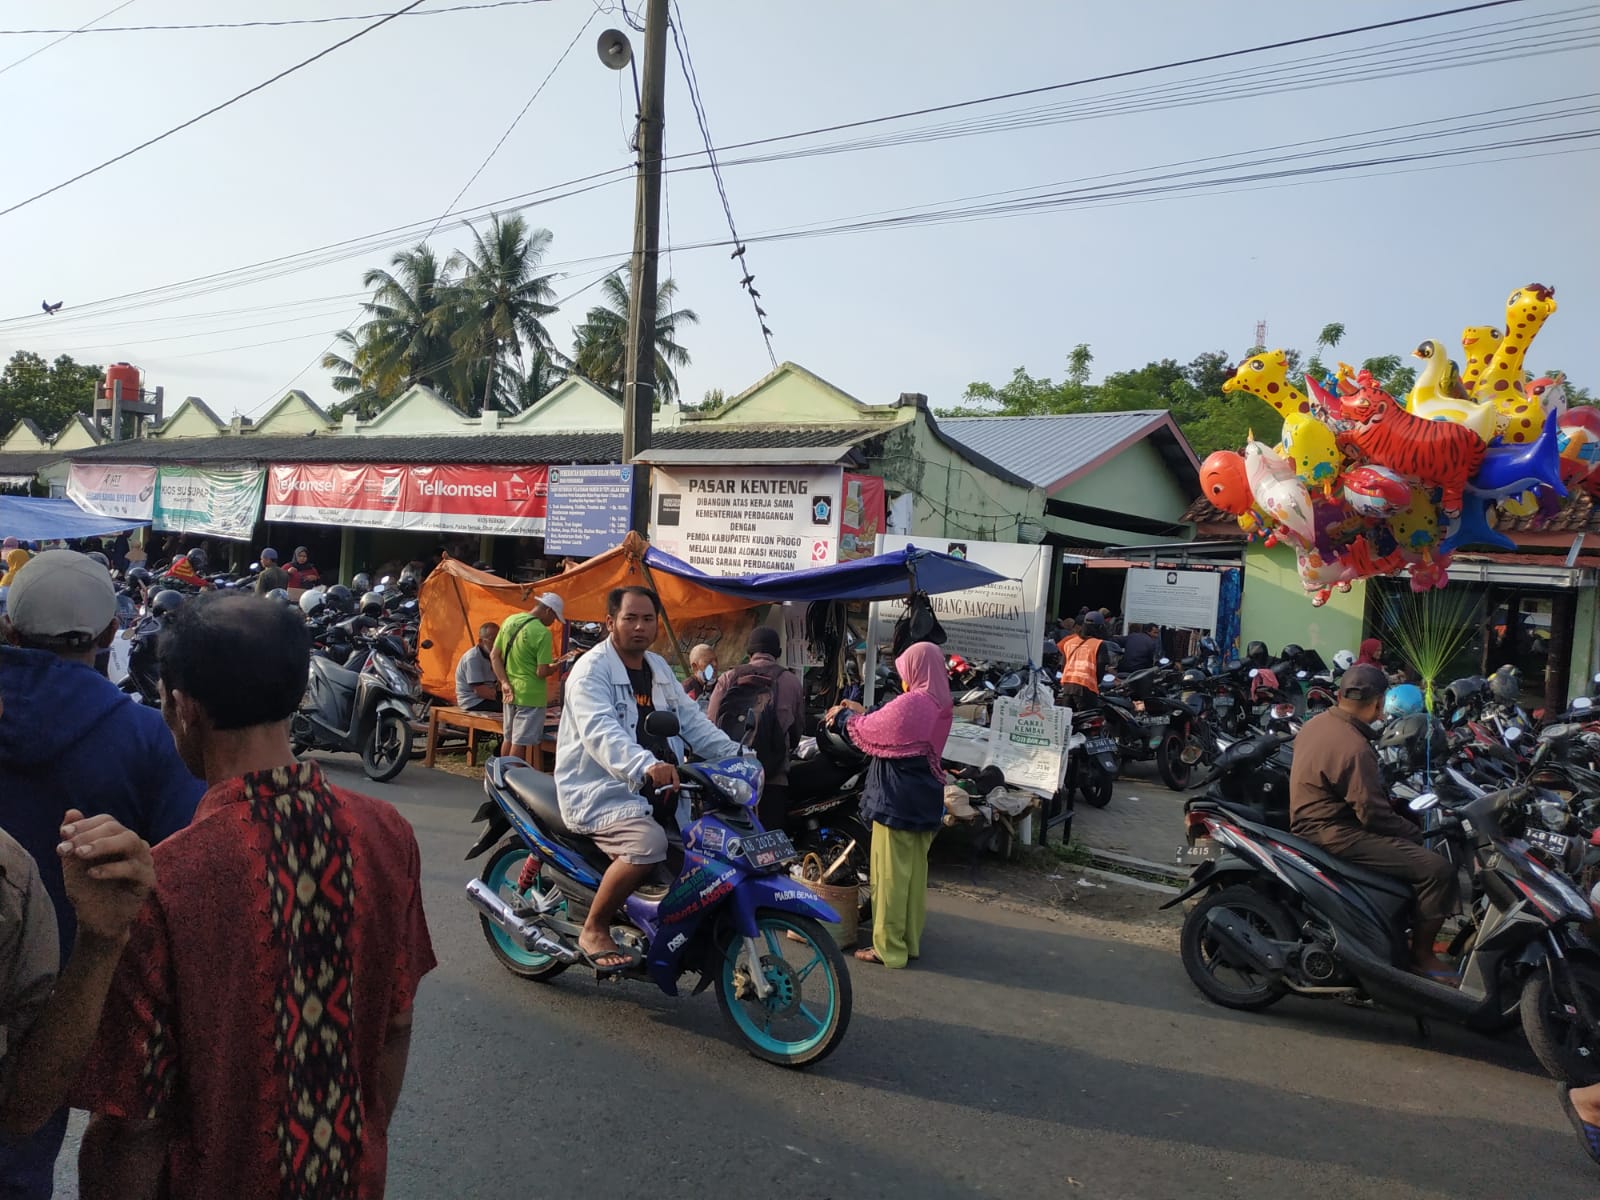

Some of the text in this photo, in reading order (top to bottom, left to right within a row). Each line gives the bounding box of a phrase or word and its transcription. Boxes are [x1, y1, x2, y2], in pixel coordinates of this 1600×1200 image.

[277, 478, 336, 493] Telkomsel
[417, 479, 497, 498] Telkomsel
[688, 479, 808, 495] PASAR KENTENG
[696, 497, 794, 509] DIBANGUN ATAS KERJA SAMA
[695, 509, 794, 521] KEMENTERIAN PERDAGANGAN
[730, 523, 756, 532] DENGAN
[686, 532, 802, 547] PEMDA KABUPATEN KULON PROGO
[689, 544, 798, 559] MELALUI DANA ALOKASI KHUSUS
[689, 555, 795, 571] BIDANG SARANA PERDAGANGAN
[721, 569, 740, 577] Tahun
[963, 600, 1020, 621] NANGGULAN
[1176, 846, 1225, 856] Z 4615 T
